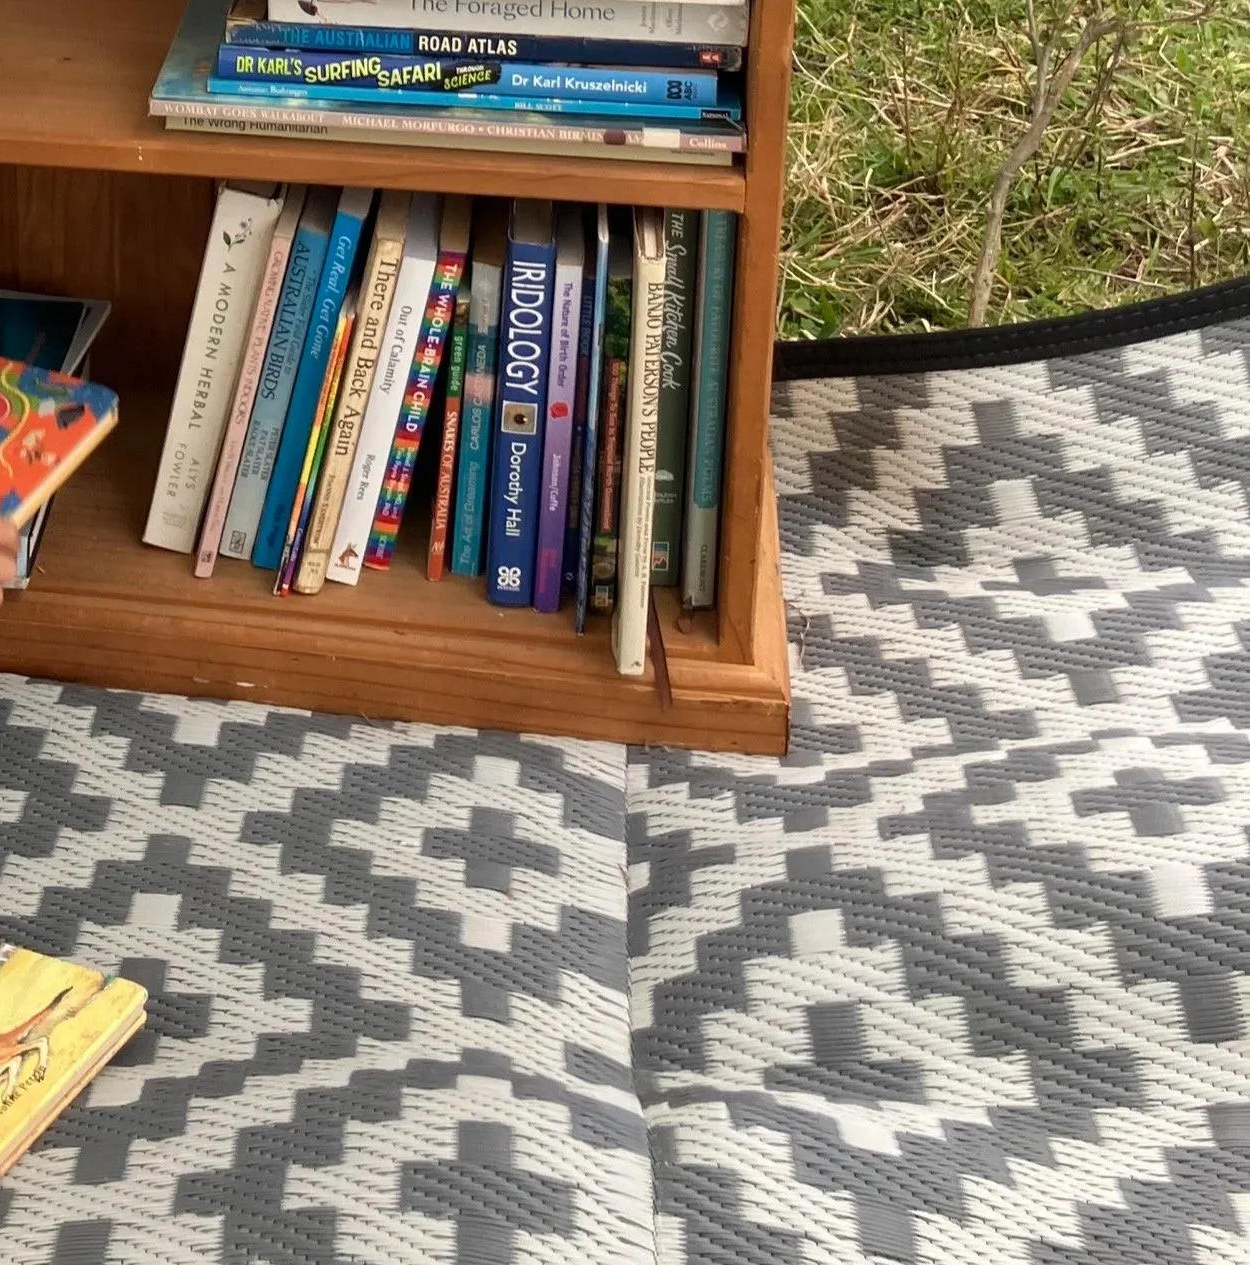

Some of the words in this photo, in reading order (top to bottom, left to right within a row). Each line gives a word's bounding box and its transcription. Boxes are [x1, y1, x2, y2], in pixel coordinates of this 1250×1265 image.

[550, 0, 616, 21] Home
[281, 29, 310, 45] THE
[314, 29, 410, 49] AUSTRALIAN
[418, 35, 463, 54] ROAD
[468, 38, 517, 56] ATLAS
[236, 56, 254, 73] DR
[257, 57, 302, 76] KARL'S
[305, 56, 381, 84] SURFING
[377, 61, 441, 87] SAFARI
[443, 69, 492, 90] SCIENCE
[456, 65, 484, 74] THROUGH
[511, 73, 529, 87] Dr
[533, 74, 560, 89] Karl
[565, 77, 647, 94] Kruszelnicki
[163, 103, 218, 115] WOMBAT
[222, 106, 257, 118] GOES
[260, 110, 325, 123] WALKABOUT
[250, 121, 328, 135] Humanitarian
[341, 115, 398, 129] MICHAEL
[400, 119, 475, 134] MORPURGO
[486, 126, 555, 140] CHRISTIAN
[689, 137, 727, 150] Collins
[671, 213, 685, 239] THE
[339, 236, 351, 260] Get
[665, 240, 687, 288] Small
[223, 262, 236, 274] A
[370, 258, 398, 310] There
[440, 264, 457, 290] THE
[272, 242, 310, 349] AUSTRALIAN
[321, 298, 336, 323] Get
[561, 297, 573, 326] Nature
[646, 282, 664, 329] BANJO
[205, 282, 232, 360] MODERN
[400, 305, 412, 326] Out
[506, 261, 547, 395] IRIDOLOGY
[662, 291, 686, 346] Kitchen
[311, 326, 329, 360] Gone
[361, 317, 380, 350] and
[396, 328, 405, 343] of
[416, 294, 450, 389] WHOLE-BRAIN
[453, 336, 463, 363] green
[261, 350, 285, 401] BIRDS
[349, 355, 374, 399] Back
[379, 343, 403, 396] Calamity
[450, 365, 461, 391] guide
[641, 334, 661, 419] PATERSON'S
[660, 352, 683, 390] Cook
[189, 367, 214, 429] HERBAL
[406, 391, 426, 433] CHILD
[335, 405, 361, 456] Again
[443, 412, 457, 451] SNAKES
[470, 408, 484, 450] CARLOS
[442, 454, 453, 469] OF
[638, 421, 658, 474] PEOPLE
[166, 442, 187, 498] FOWLER
[361, 454, 375, 482] Roger
[503, 441, 527, 505] Dorothy
[356, 481, 369, 501] Rees
[436, 470, 452, 529] AUSTRALIA
[505, 507, 522, 537] Hall
